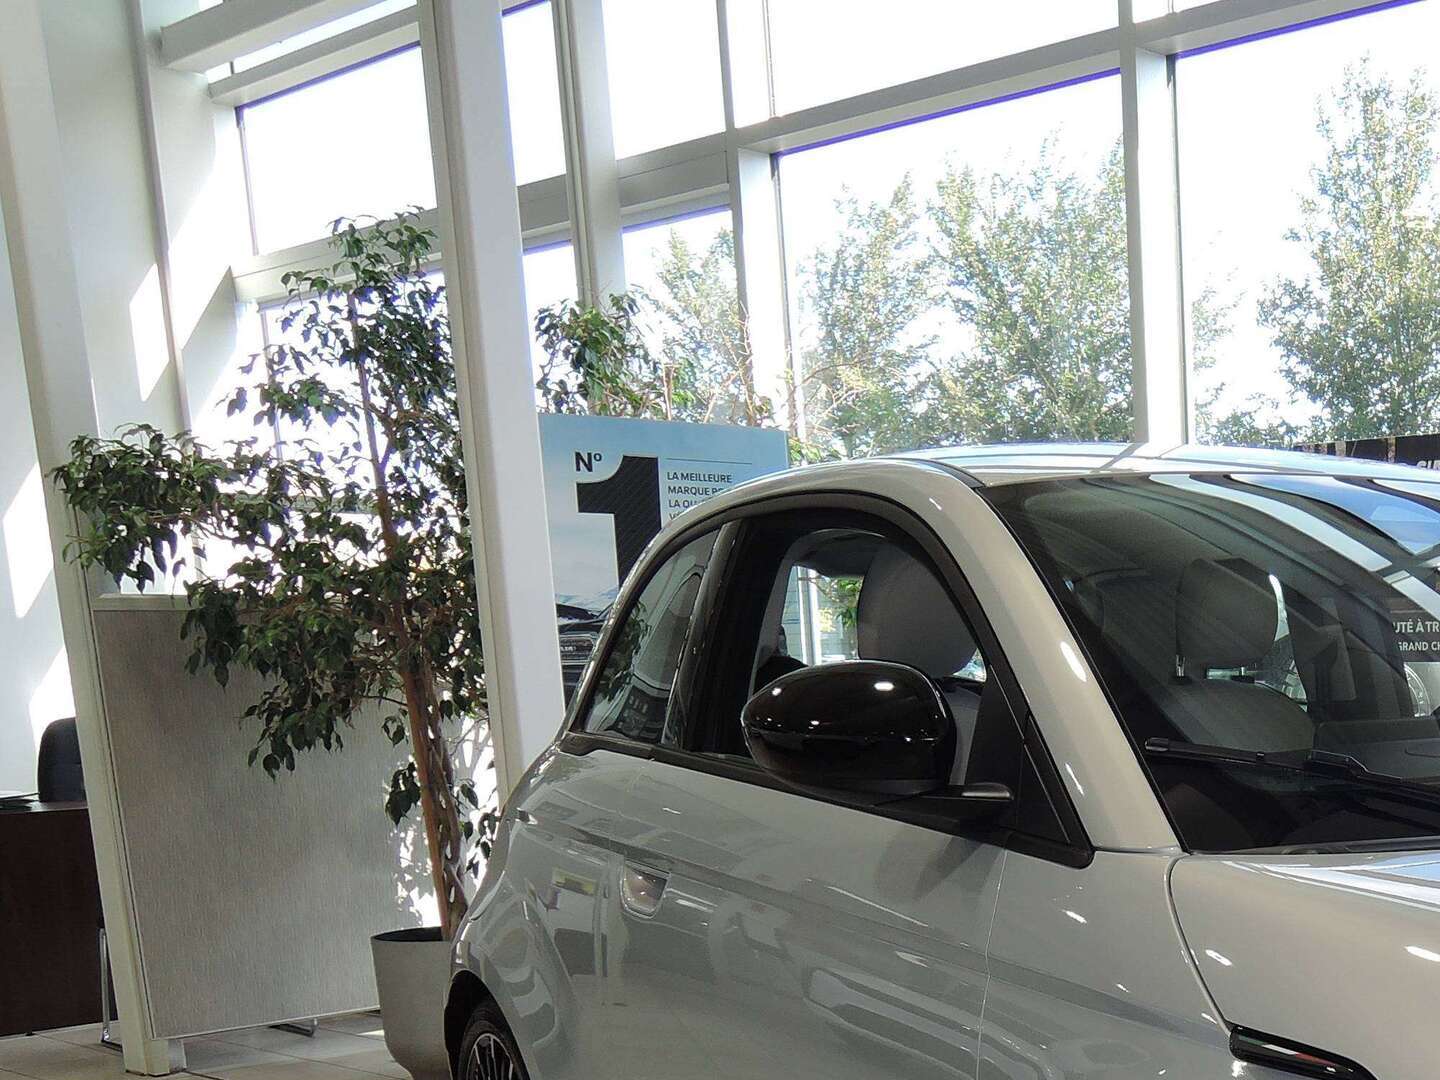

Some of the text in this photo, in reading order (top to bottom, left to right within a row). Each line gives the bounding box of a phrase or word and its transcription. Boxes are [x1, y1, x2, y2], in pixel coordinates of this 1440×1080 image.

[667, 471, 732, 483] LA MEILLEURE
[667, 486, 710, 496] MARQUE
[668, 499, 680, 508] LA
[576, 455, 662, 592] 1
[1415, 618, 1424, 632] À
